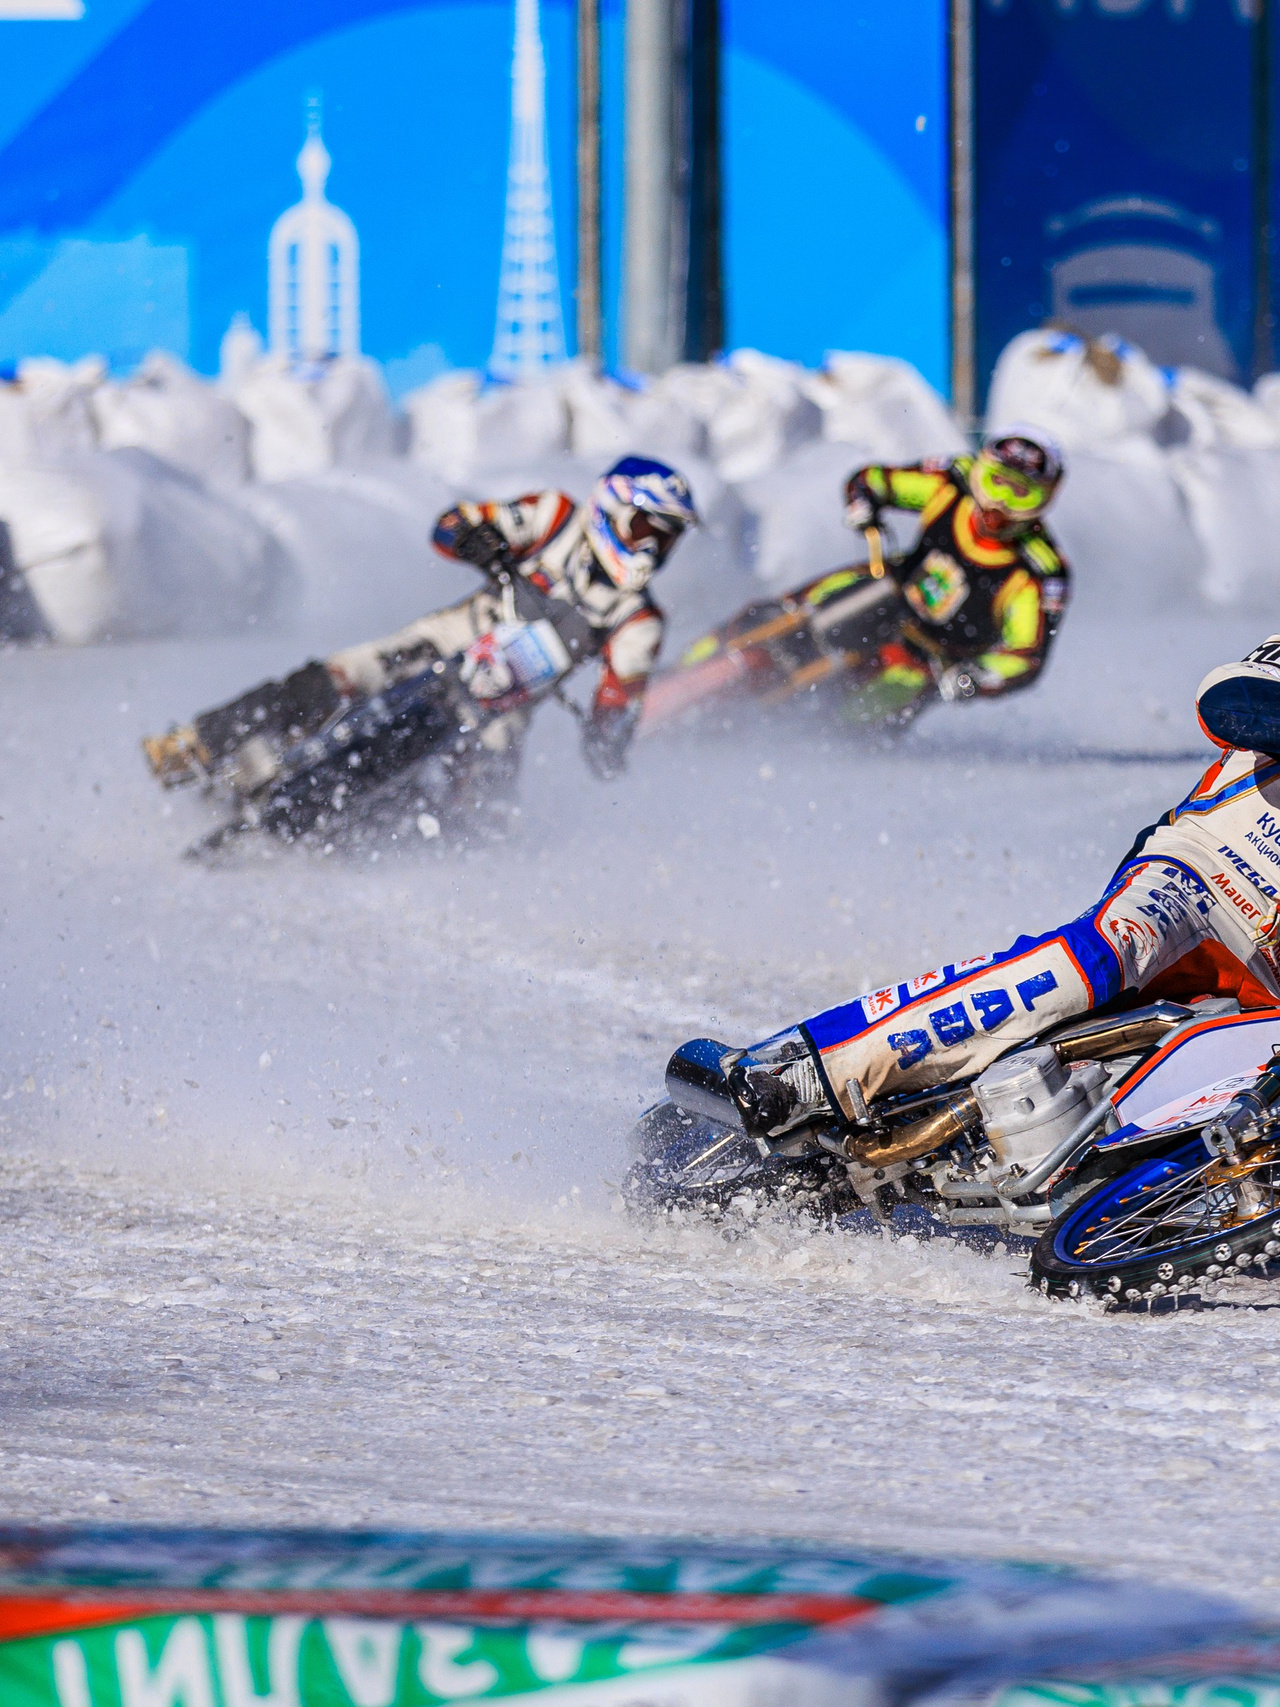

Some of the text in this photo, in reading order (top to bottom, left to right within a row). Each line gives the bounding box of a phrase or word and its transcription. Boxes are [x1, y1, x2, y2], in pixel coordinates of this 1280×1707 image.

[1210, 872, 1261, 920] Mauer
[874, 987, 894, 1011] GK
[887, 970, 1058, 1070] LADA
